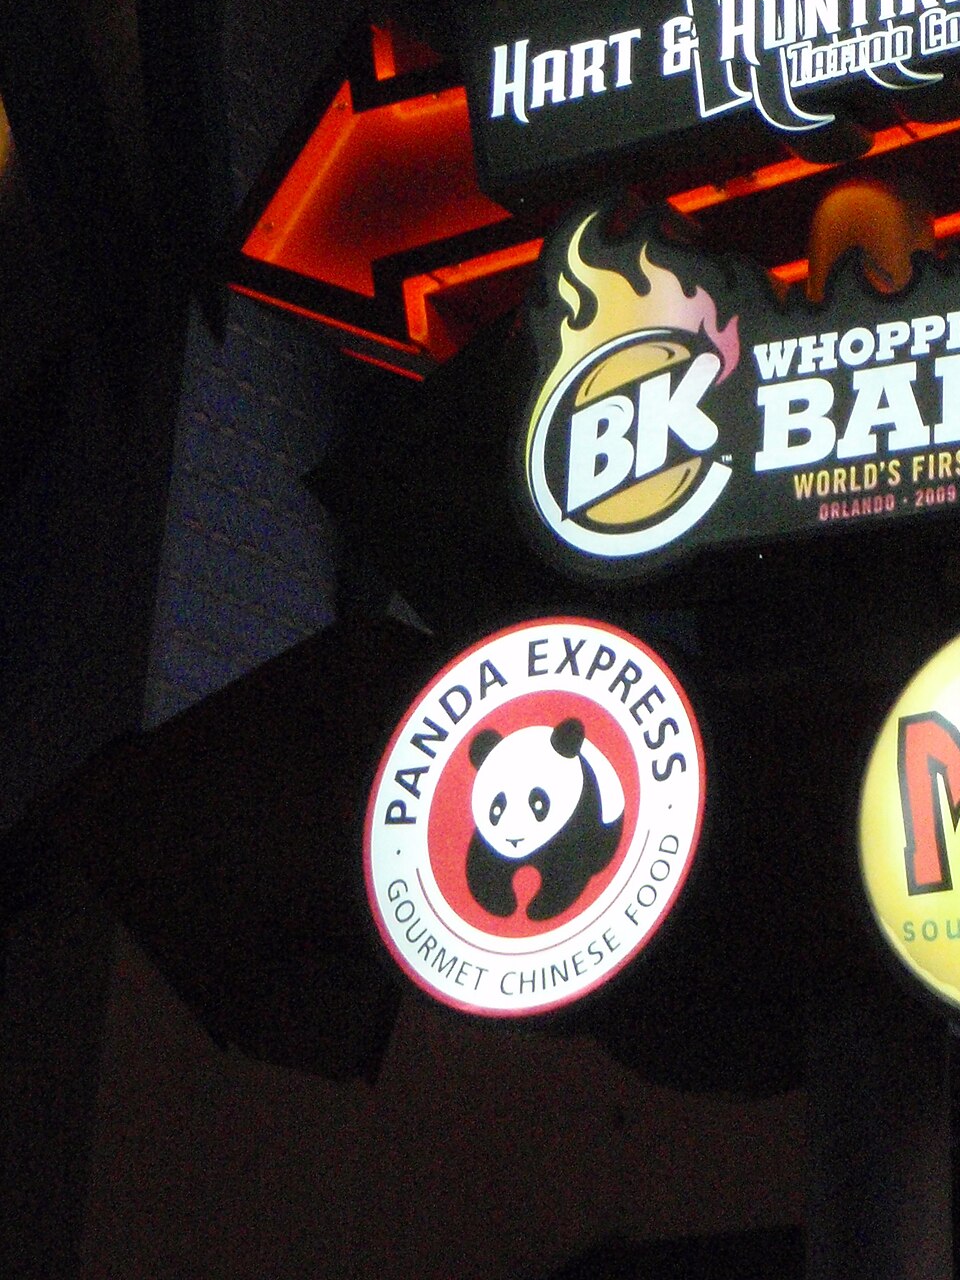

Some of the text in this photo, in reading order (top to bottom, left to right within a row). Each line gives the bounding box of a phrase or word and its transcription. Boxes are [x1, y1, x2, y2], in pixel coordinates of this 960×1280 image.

[491, 28, 642, 122] HART
[663, 16, 698, 77] &
[567, 352, 720, 513] BK
[793, 459, 901, 500] WORLD'S
[819, 483, 959, 521] ORLANDO 2009
[384, 637, 687, 825] PANDA EXPRESS
[387, 833, 680, 995] GOURMET CHINESE FOOD
